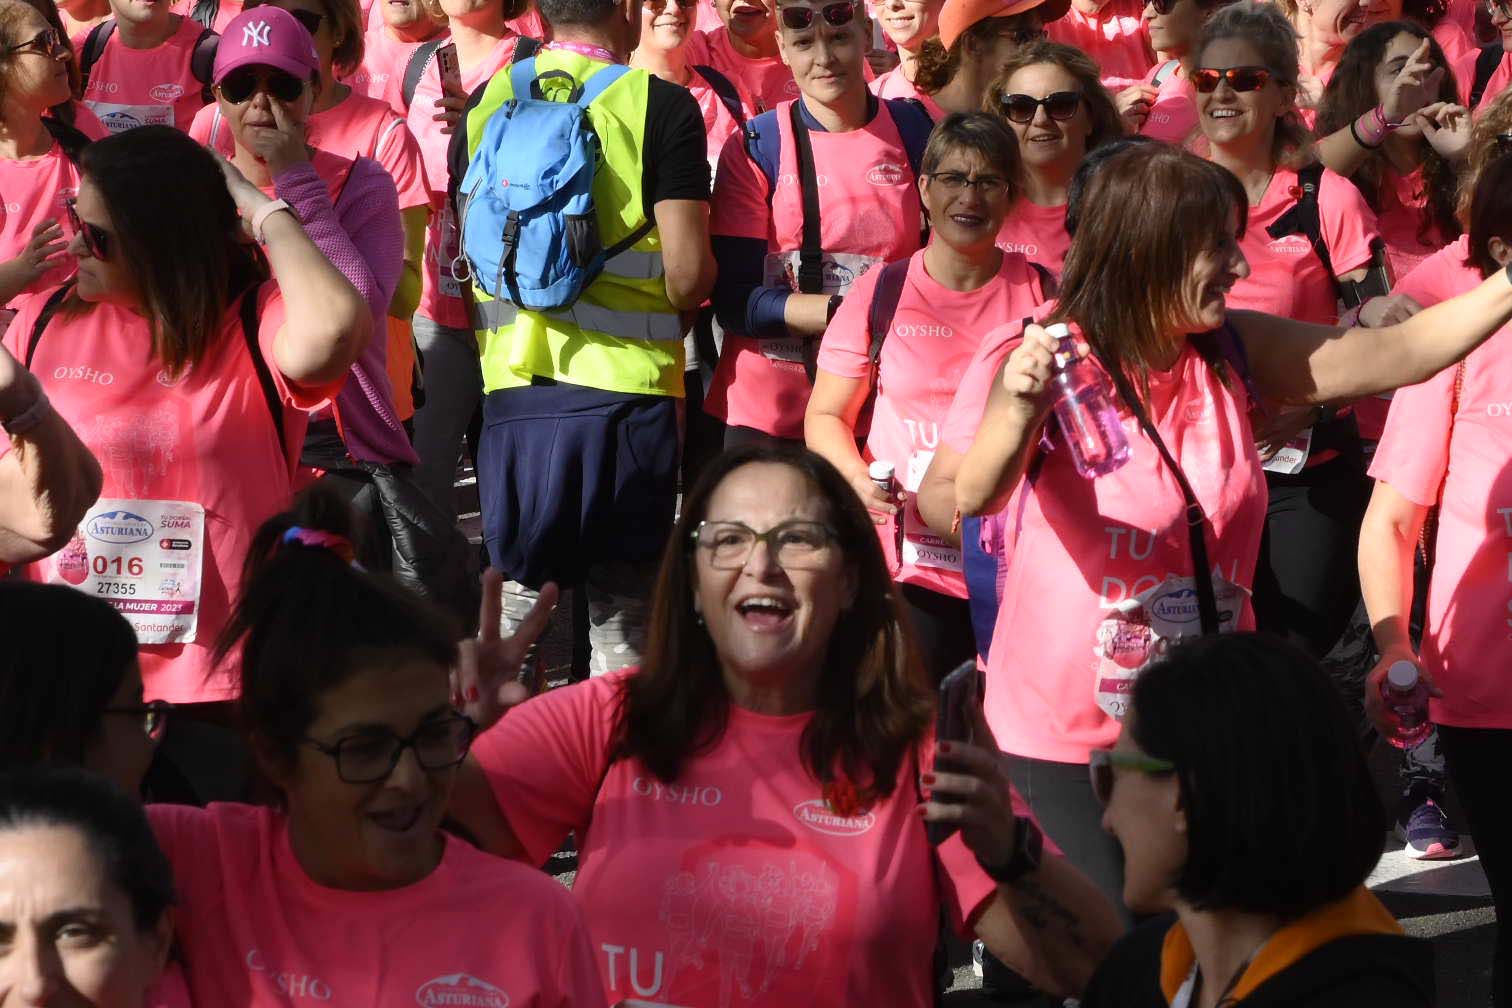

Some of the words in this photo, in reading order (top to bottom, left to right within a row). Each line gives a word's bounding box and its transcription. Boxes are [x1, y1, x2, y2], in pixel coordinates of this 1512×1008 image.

[896, 324, 953, 338] OYSHO
[54, 365, 114, 386] OYSHO
[903, 419, 939, 449] TU
[91, 522, 149, 537] ASTURIANA
[160, 520, 192, 529] SUMA
[1104, 527, 1157, 560] TU
[93, 555, 144, 576] 016
[917, 549, 957, 564] OYSHO
[97, 582, 136, 595] 27355
[125, 602, 158, 611] MUJER
[134, 622, 184, 633] Santander
[632, 776, 722, 807] OYSHO
[800, 807, 871, 830] ASTURIANA
[601, 943, 664, 997] TU
